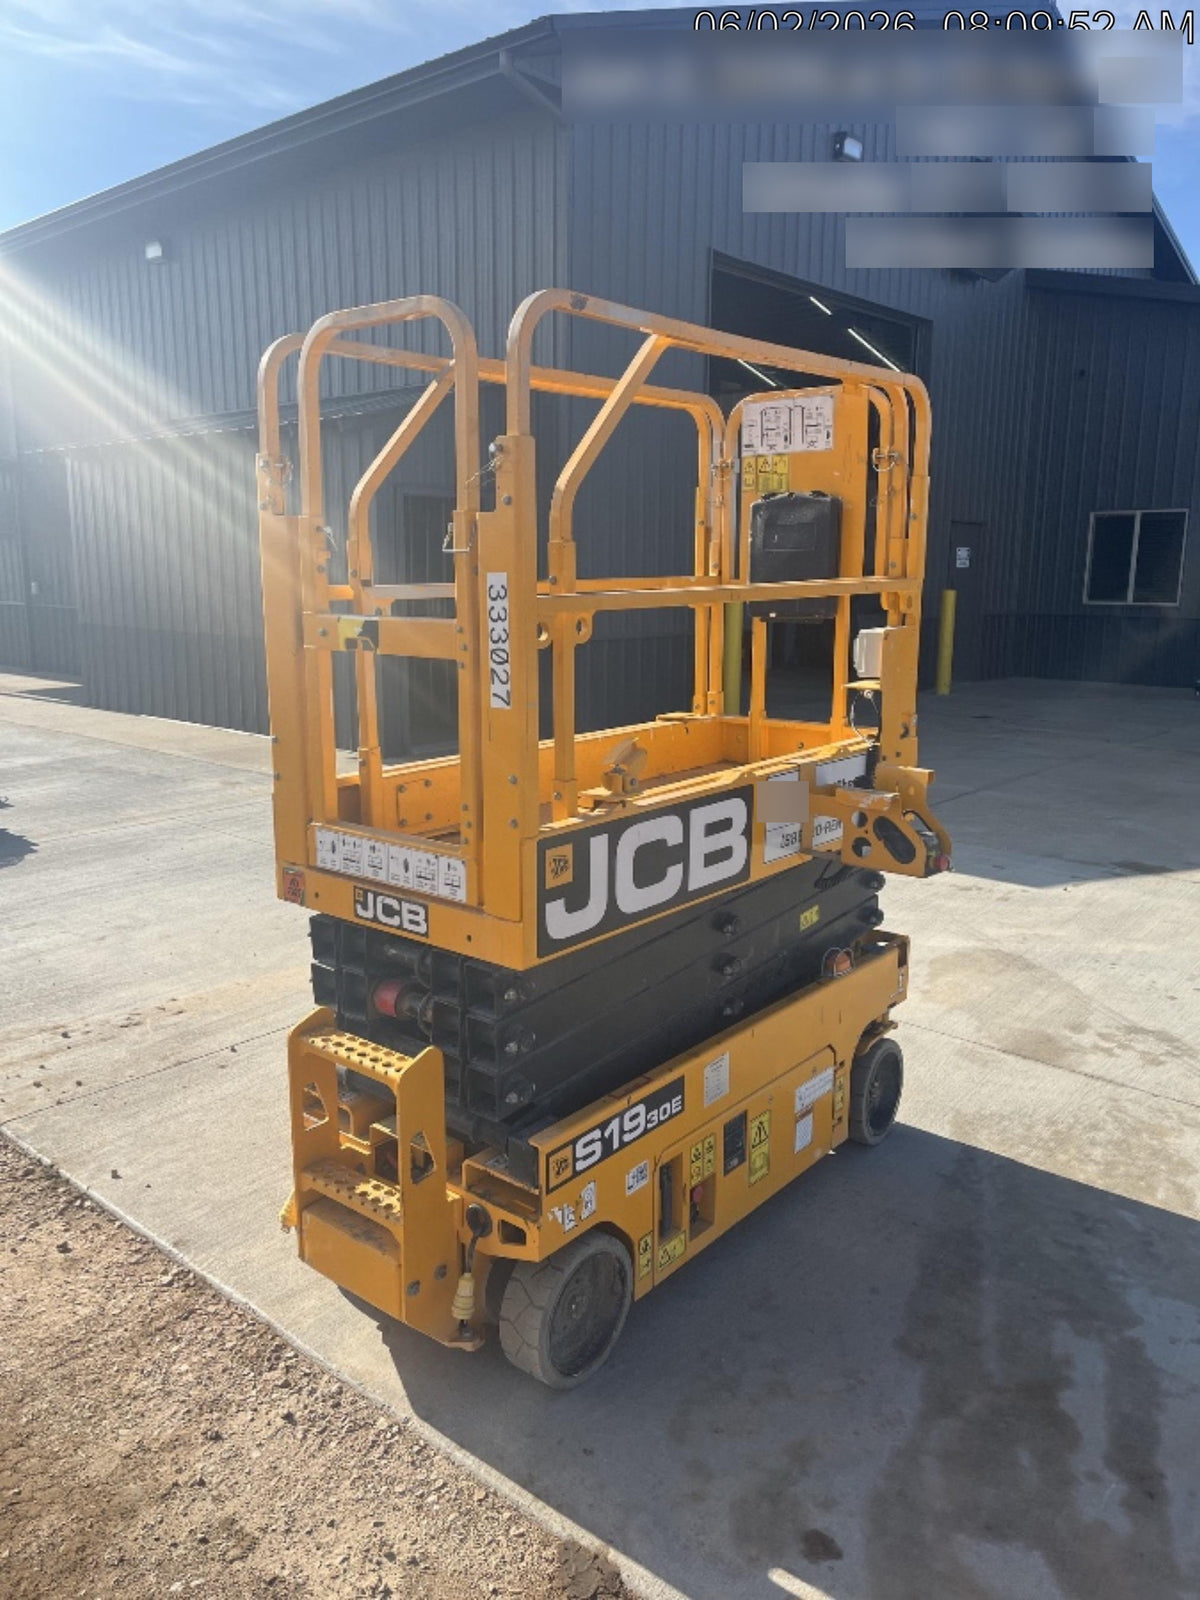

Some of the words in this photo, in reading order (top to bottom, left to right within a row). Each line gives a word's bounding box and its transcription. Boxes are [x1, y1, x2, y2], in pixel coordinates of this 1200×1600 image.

[488, 584, 511, 707] 333027
[356, 892, 427, 934] JCB
[545, 798, 747, 940] JCB
